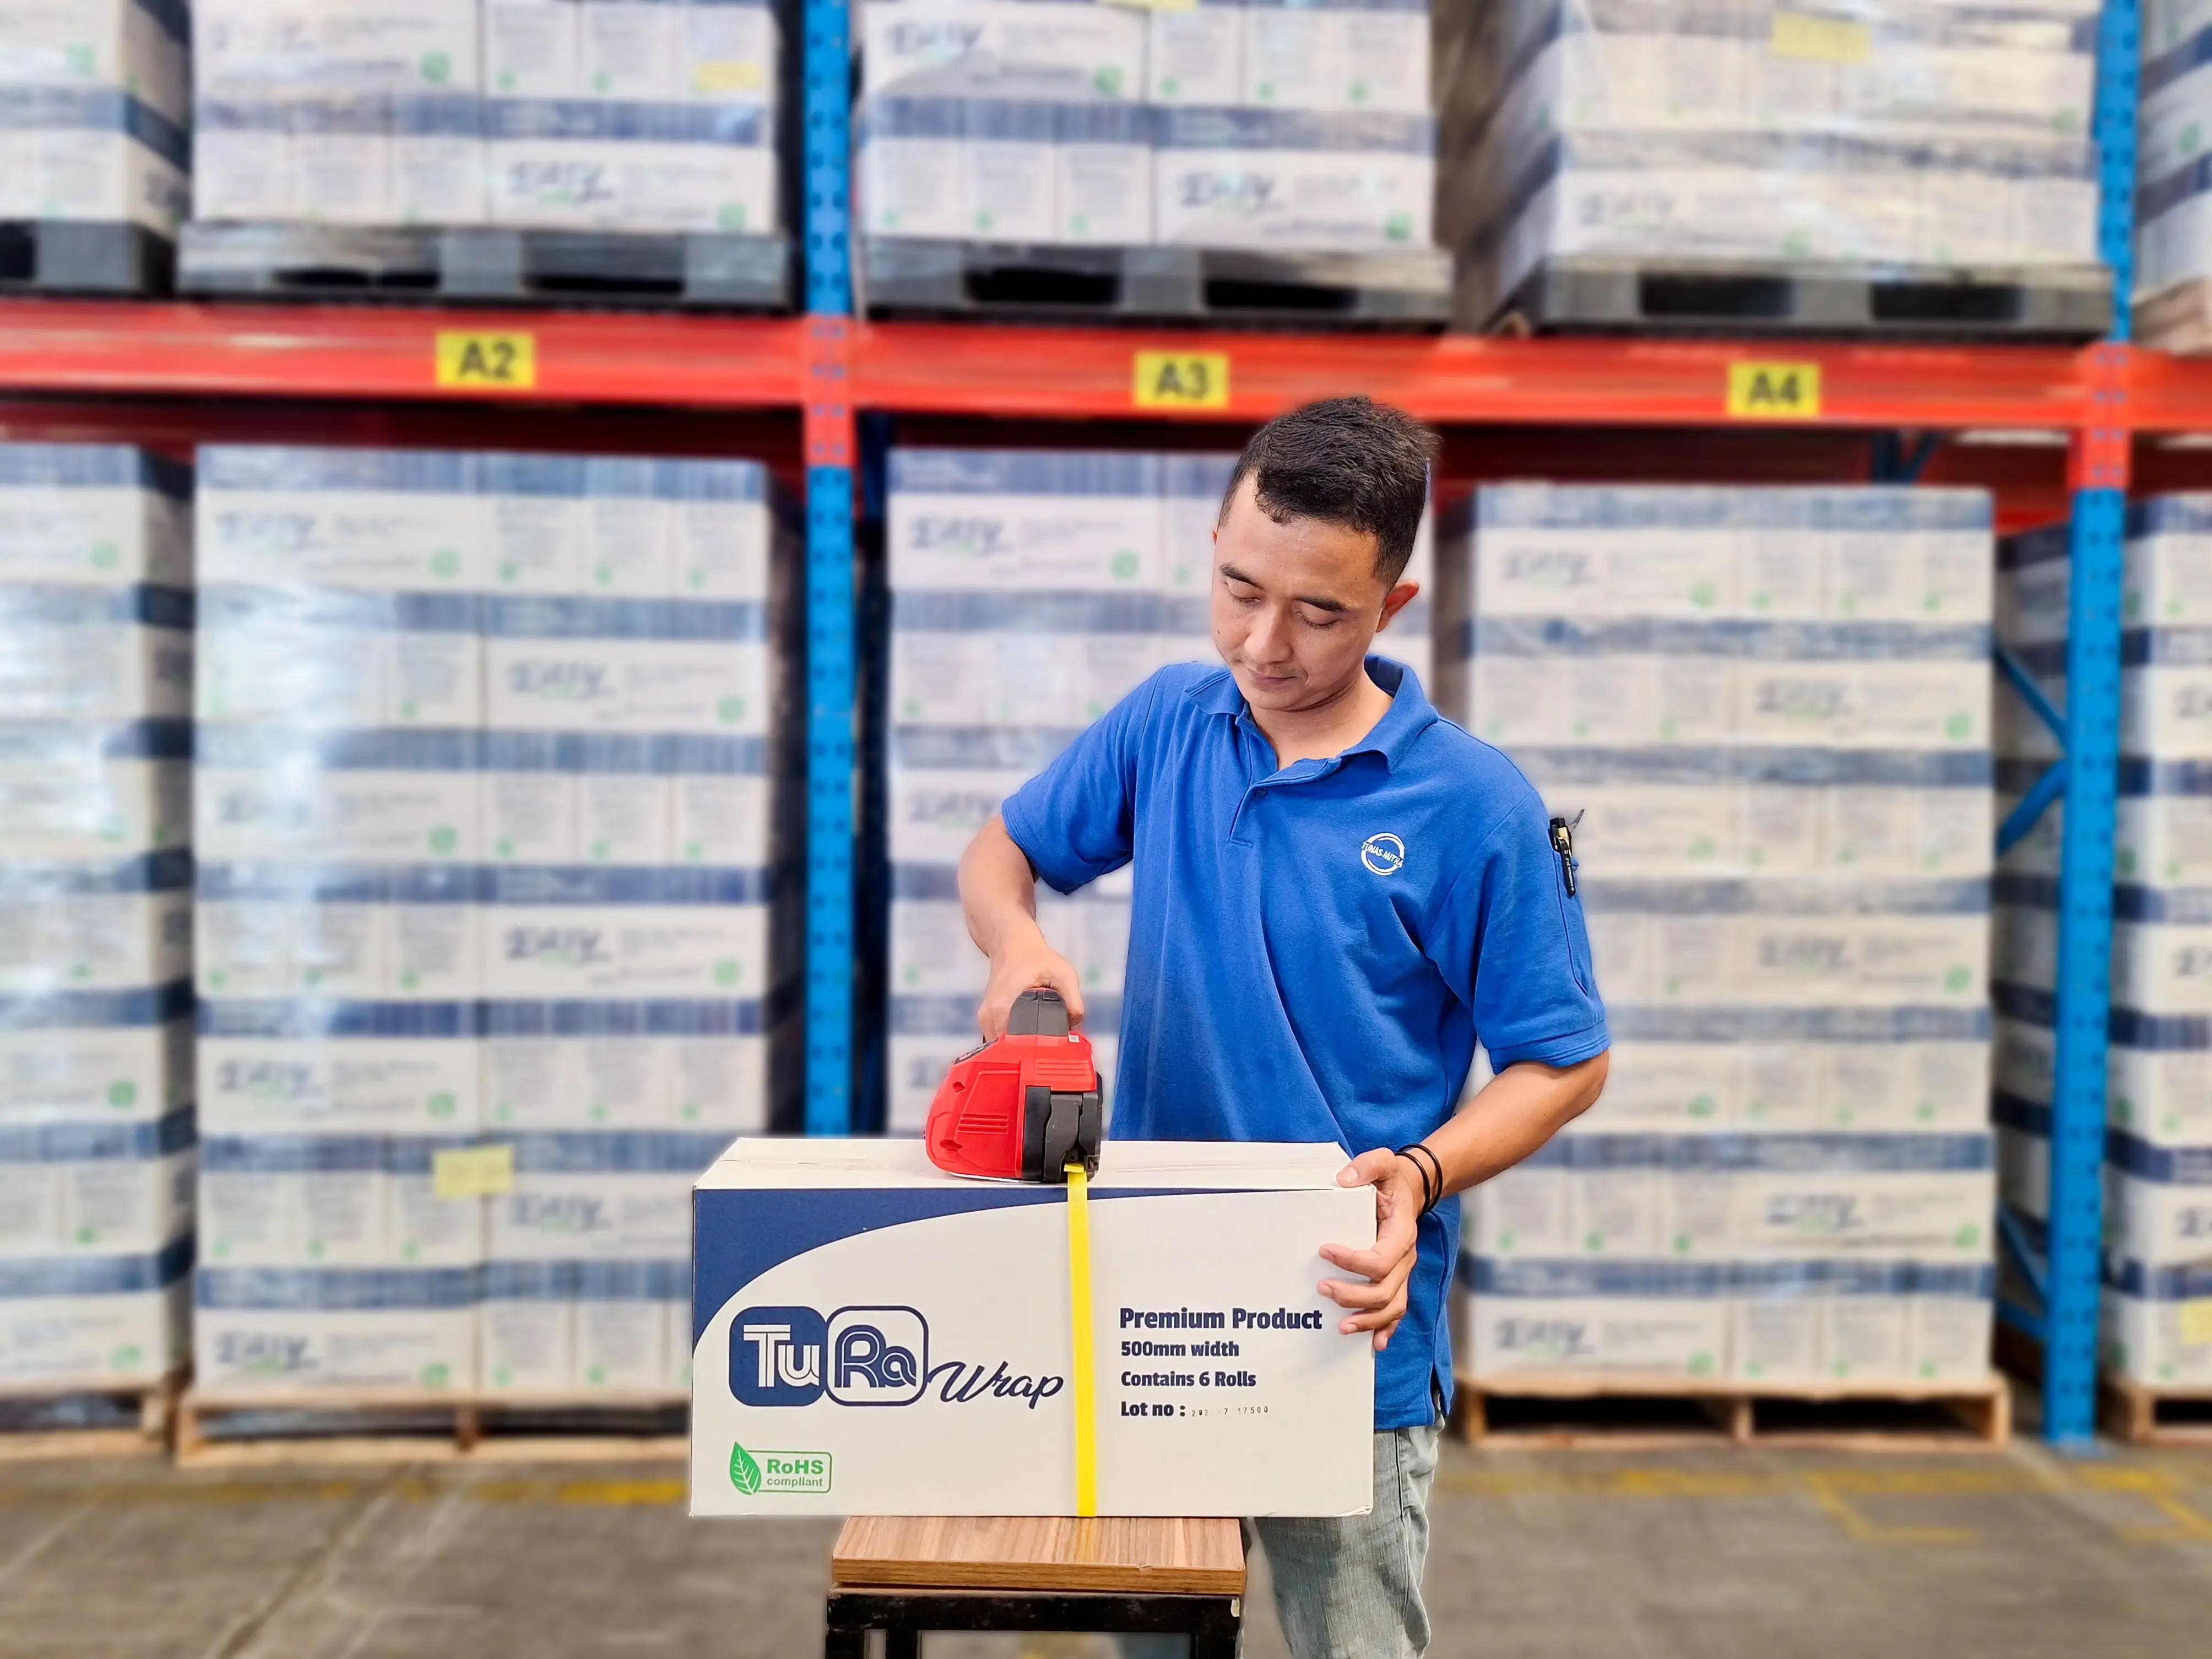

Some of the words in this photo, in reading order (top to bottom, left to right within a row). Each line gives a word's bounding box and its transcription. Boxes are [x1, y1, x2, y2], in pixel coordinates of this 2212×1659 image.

[458, 340, 516, 379] A2
[1154, 361, 1209, 399] A3
[1748, 370, 1801, 406] A4
[1120, 1307, 1225, 1329] Premium
[1232, 1308, 1322, 1330] Product
[1121, 1341, 1186, 1357] 500mm
[1191, 1341, 1239, 1357] width
[927, 1360, 1064, 1409] Wrap
[1121, 1371, 1195, 1386] Contains
[1199, 1371, 1210, 1386] 6
[1215, 1371, 1256, 1387] Rolls
[1121, 1401, 1148, 1417] Lot
[767, 1459, 823, 1474] RoHS
[767, 1477, 823, 1488] compliant
